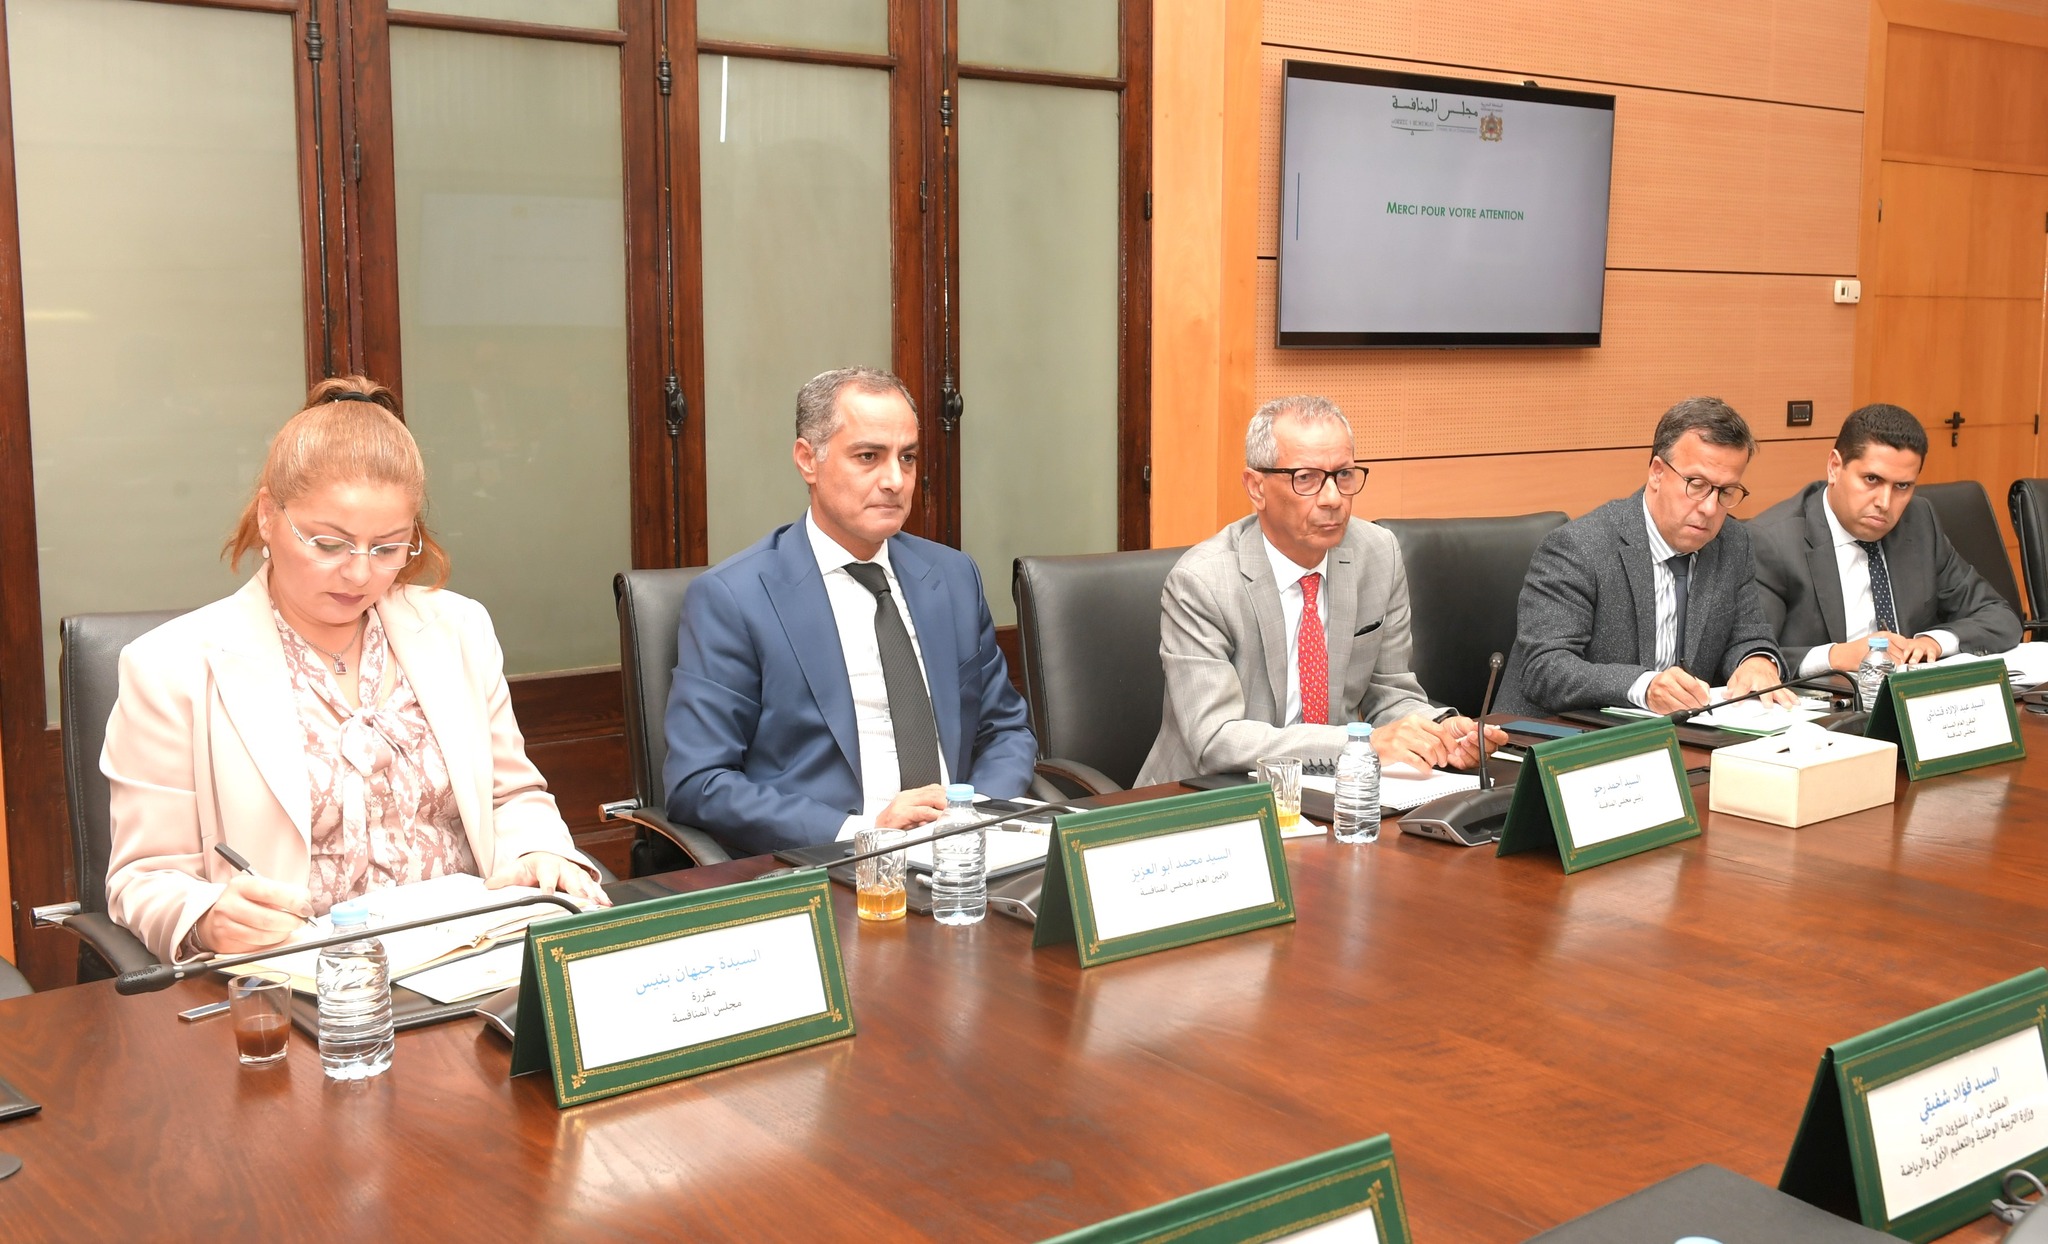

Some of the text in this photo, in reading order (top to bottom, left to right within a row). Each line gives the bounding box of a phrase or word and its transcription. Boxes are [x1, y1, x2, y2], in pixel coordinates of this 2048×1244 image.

[1392, 95, 1478, 121] مجلس المنافسة
[1421, 205, 1446, 217] POUR
[1449, 207, 1477, 218] VOTRE
[1479, 209, 1525, 220] ATTENTION
[1176, 857, 1202, 869] محمد
[1206, 848, 1231, 865] السيد
[1140, 883, 1168, 896] المنافسة
[635, 949, 761, 996] السيدة جيهان بنيس
[692, 988, 717, 1003] مقررة
[672, 1001, 742, 1023] مجلس المنافسة
[1919, 1066, 2000, 1126] السيد فؤاد شفيقي
[1970, 1107, 1984, 1127] العام
[1986, 1096, 2010, 1119] المفتش
[2019, 1108, 2035, 1125] وزارة
[1976, 1122, 2000, 1144] الوطنية
[2001, 1113, 2019, 1133] التربية
[1900, 1156, 1931, 1177] والرياضة
